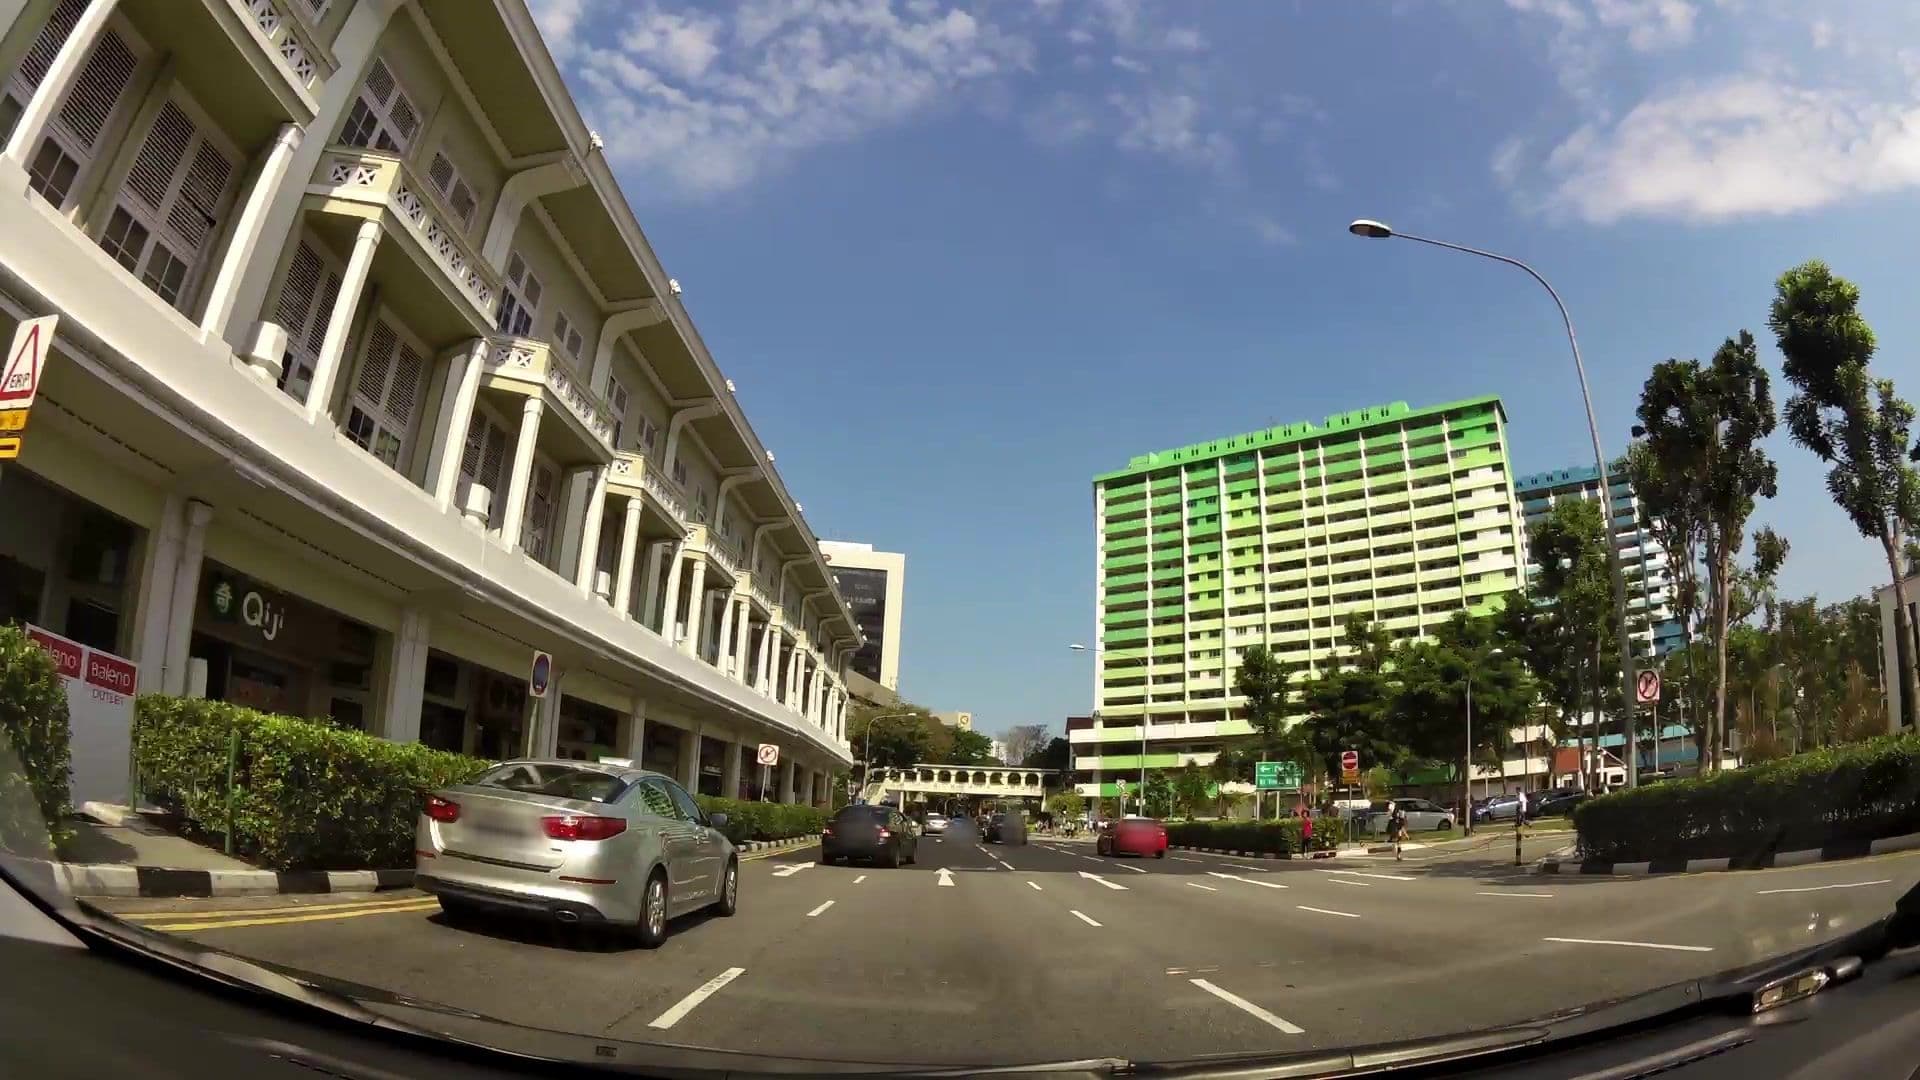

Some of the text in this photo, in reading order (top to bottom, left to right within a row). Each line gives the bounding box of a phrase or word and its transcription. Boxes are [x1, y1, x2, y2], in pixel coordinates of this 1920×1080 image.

[9, 373, 30, 389] ERP
[243, 592, 284, 640] Qiji
[91, 662, 131, 687] Baleno
[92, 689, 124, 706] OUTLET
